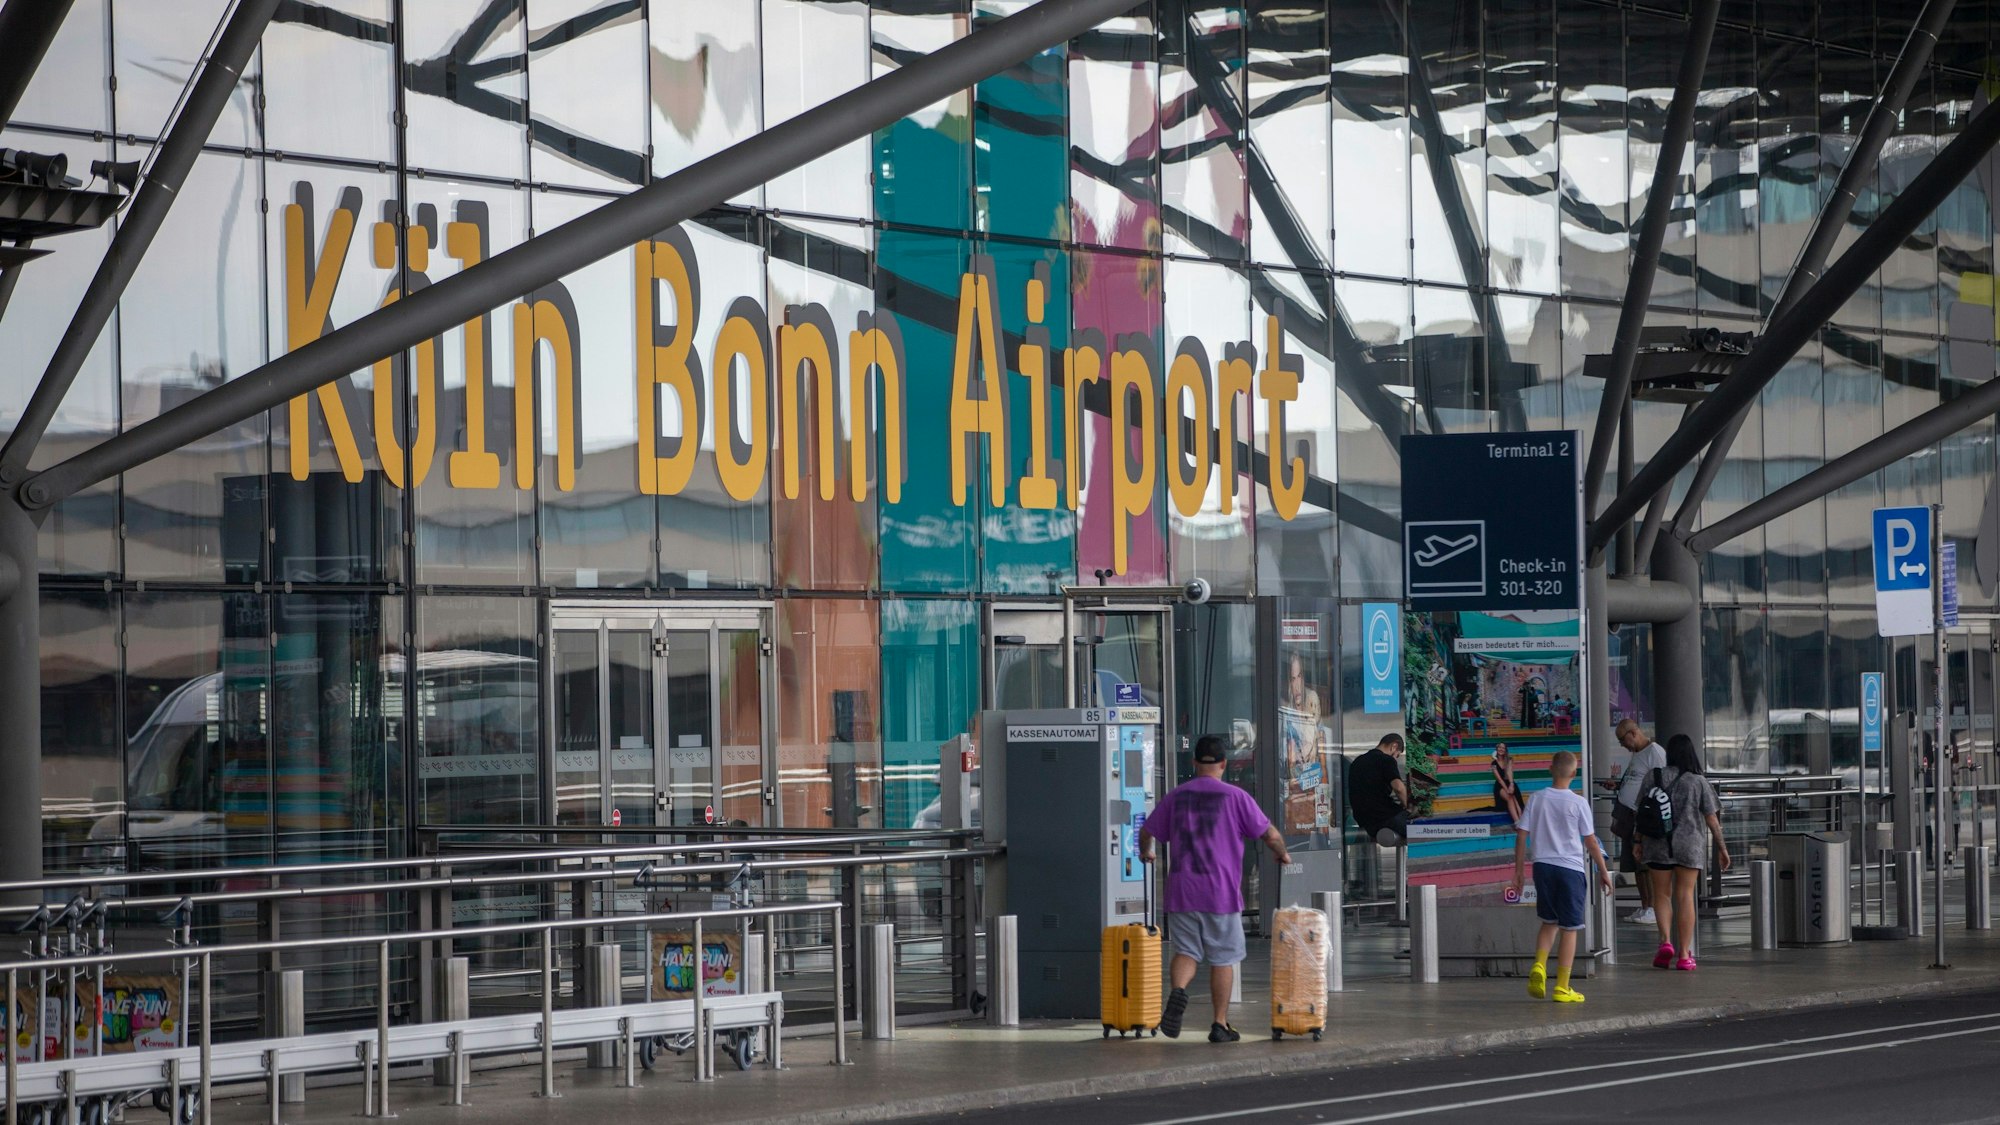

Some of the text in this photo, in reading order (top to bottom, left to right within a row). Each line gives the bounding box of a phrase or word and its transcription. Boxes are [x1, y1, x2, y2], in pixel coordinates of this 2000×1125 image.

[285, 203, 1304, 575] Köln Bonn Airport
[1486, 442, 1569, 458] Terminal 2
[1886, 519, 1916, 580] P
[1500, 558, 1566, 573] Check-in
[1500, 580, 1562, 596] 301-320
[1486, 641, 1520, 649] bedeutet
[1522, 640, 1534, 648] für
[1086, 711, 1100, 721] 85
[1109, 711, 1158, 721] P KASSENAUTOMAT
[1010, 729, 1096, 738] KASSENAUTOMAT
[1811, 867, 1822, 930] Abfall
[102, 999, 132, 1015] AVE
[134, 1000, 171, 1016] FUN!
